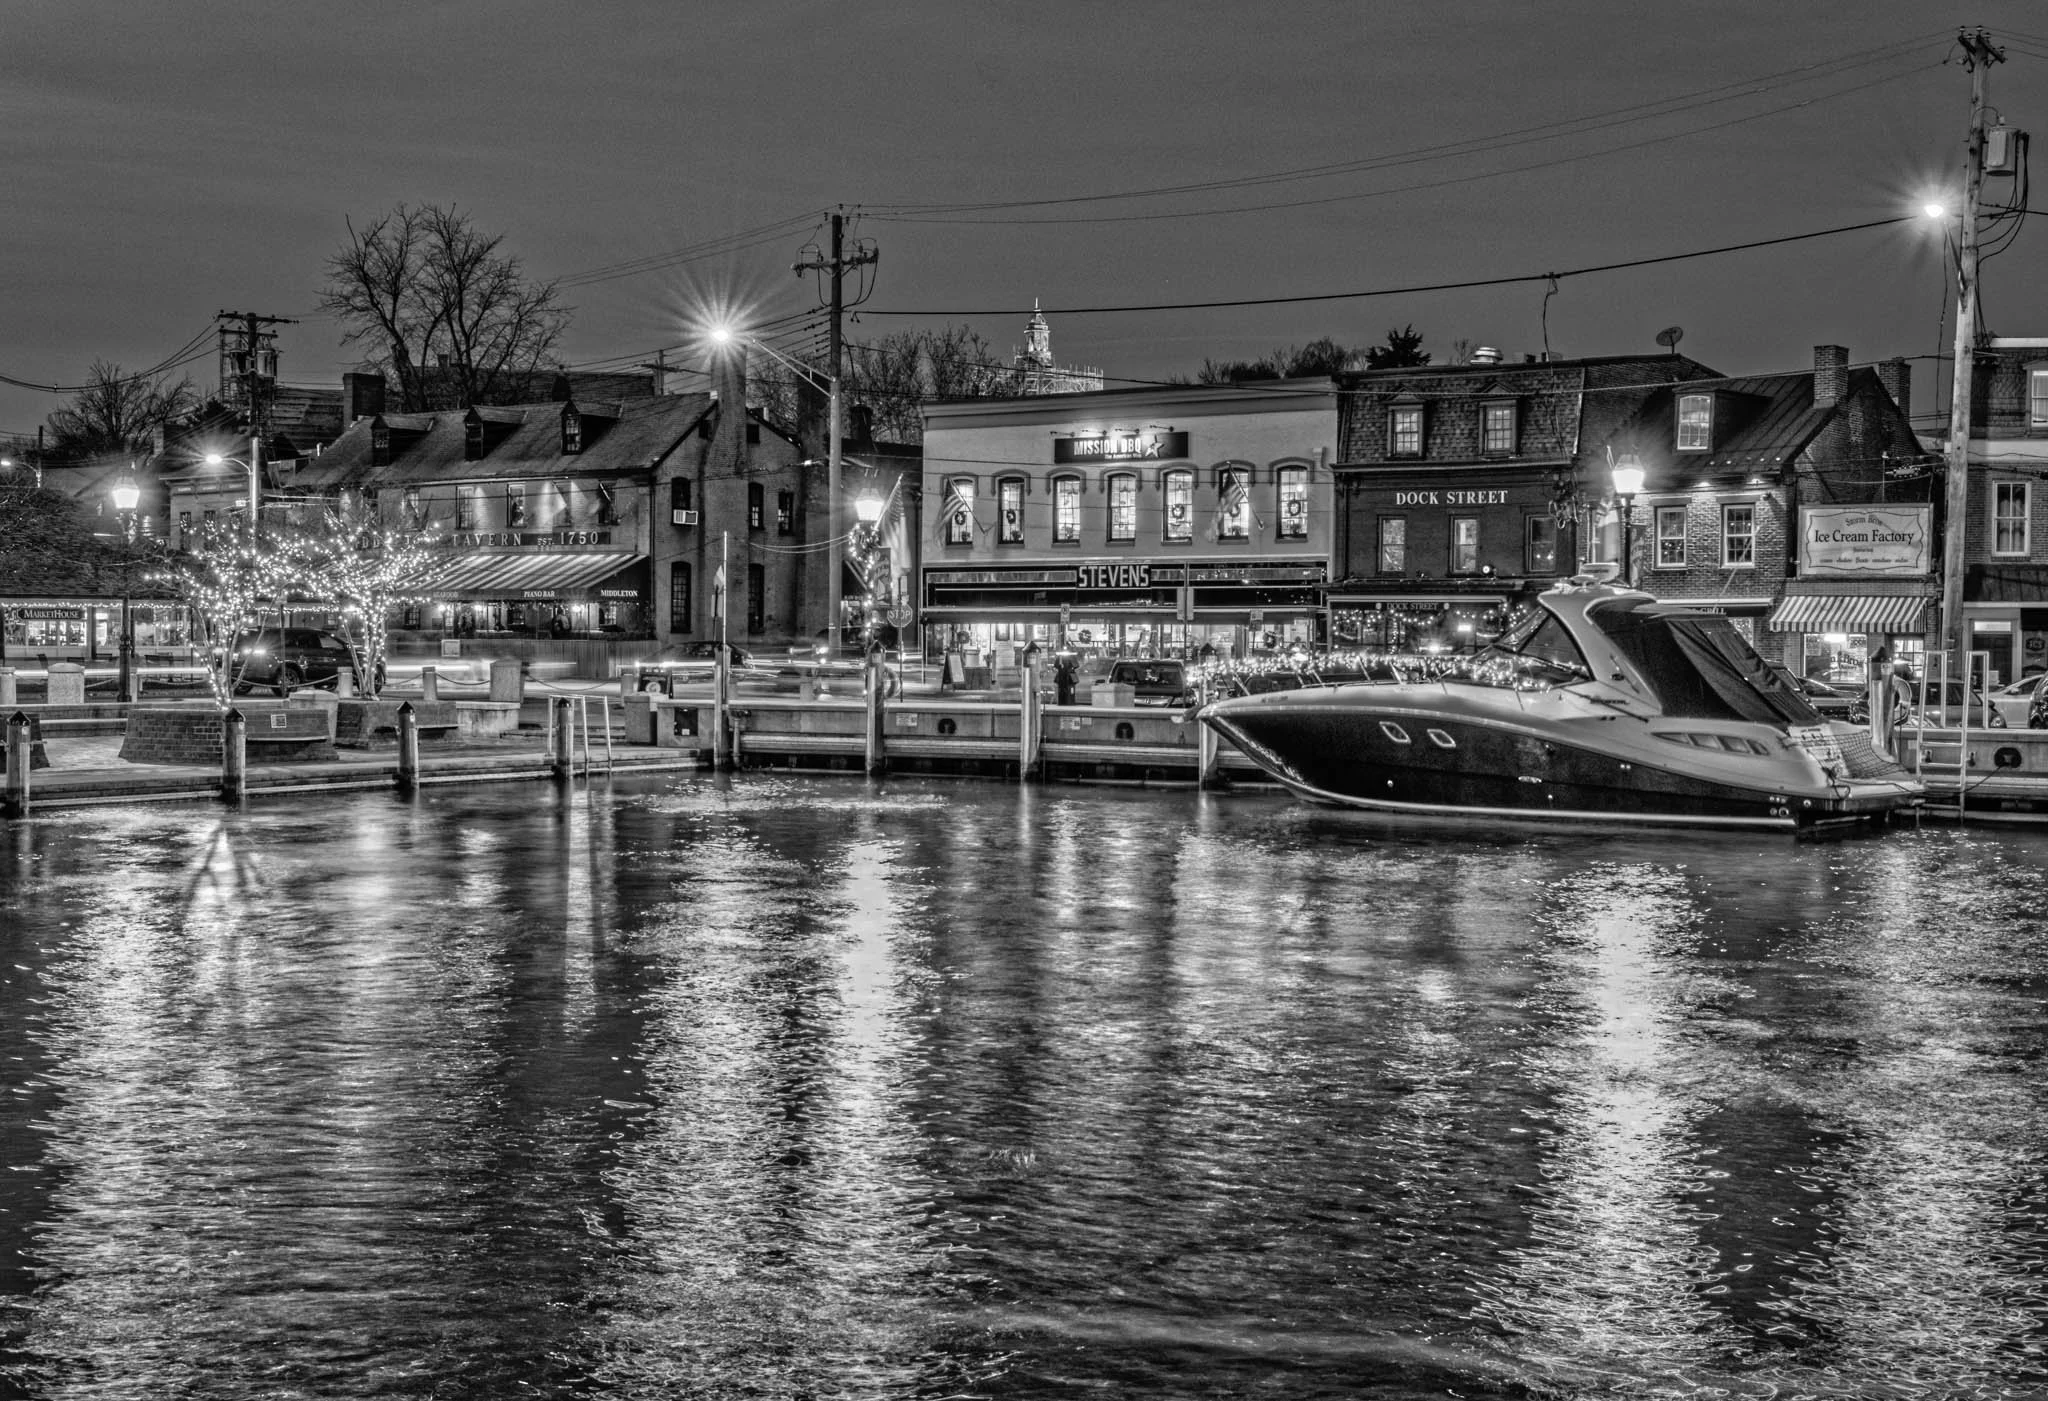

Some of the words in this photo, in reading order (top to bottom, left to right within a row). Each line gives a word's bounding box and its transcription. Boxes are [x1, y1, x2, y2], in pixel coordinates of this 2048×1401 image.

[1073, 440, 1117, 455] MISSION
[1396, 491, 1439, 505] DOCK
[1446, 490, 1508, 505] STREET
[452, 533, 521, 546] TAVERN
[560, 531, 599, 545] 1750
[1815, 529, 1830, 542] Ice
[1832, 529, 1869, 542] Cream
[1872, 529, 1914, 544] Factory
[1078, 565, 1149, 588] STEVENS
[543, 590, 555, 598] BAR
[600, 589, 638, 597] MIDDLETON
[887, 609, 911, 620] STOP
